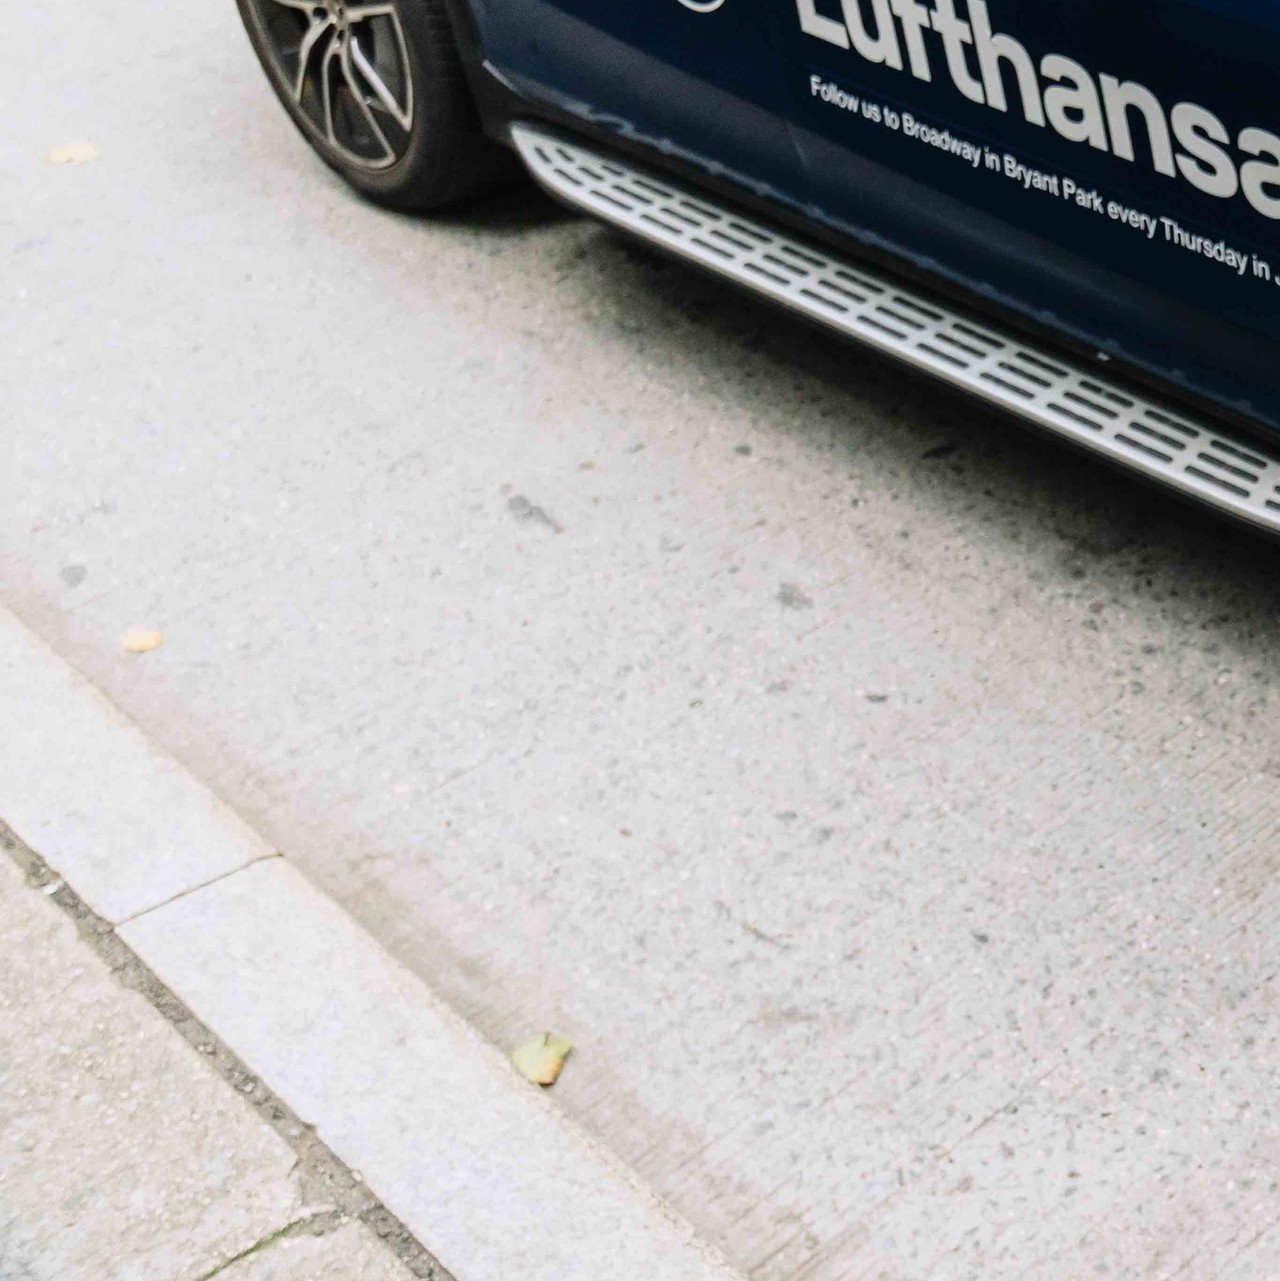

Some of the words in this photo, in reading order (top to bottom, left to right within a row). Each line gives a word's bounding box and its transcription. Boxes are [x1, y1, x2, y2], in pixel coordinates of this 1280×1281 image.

[810, 74, 860, 114] Follow
[861, 101, 882, 124] us
[883, 105, 901, 131] to
[902, 112, 983, 169] Broadway
[984, 145, 1002, 173] in
[1003, 153, 1061, 198] Bryant
[1061, 177, 1105, 215] Park
[1106, 200, 1158, 240] every
[1159, 216, 1249, 276] Thursday
[1251, 253, 1272, 282] in
